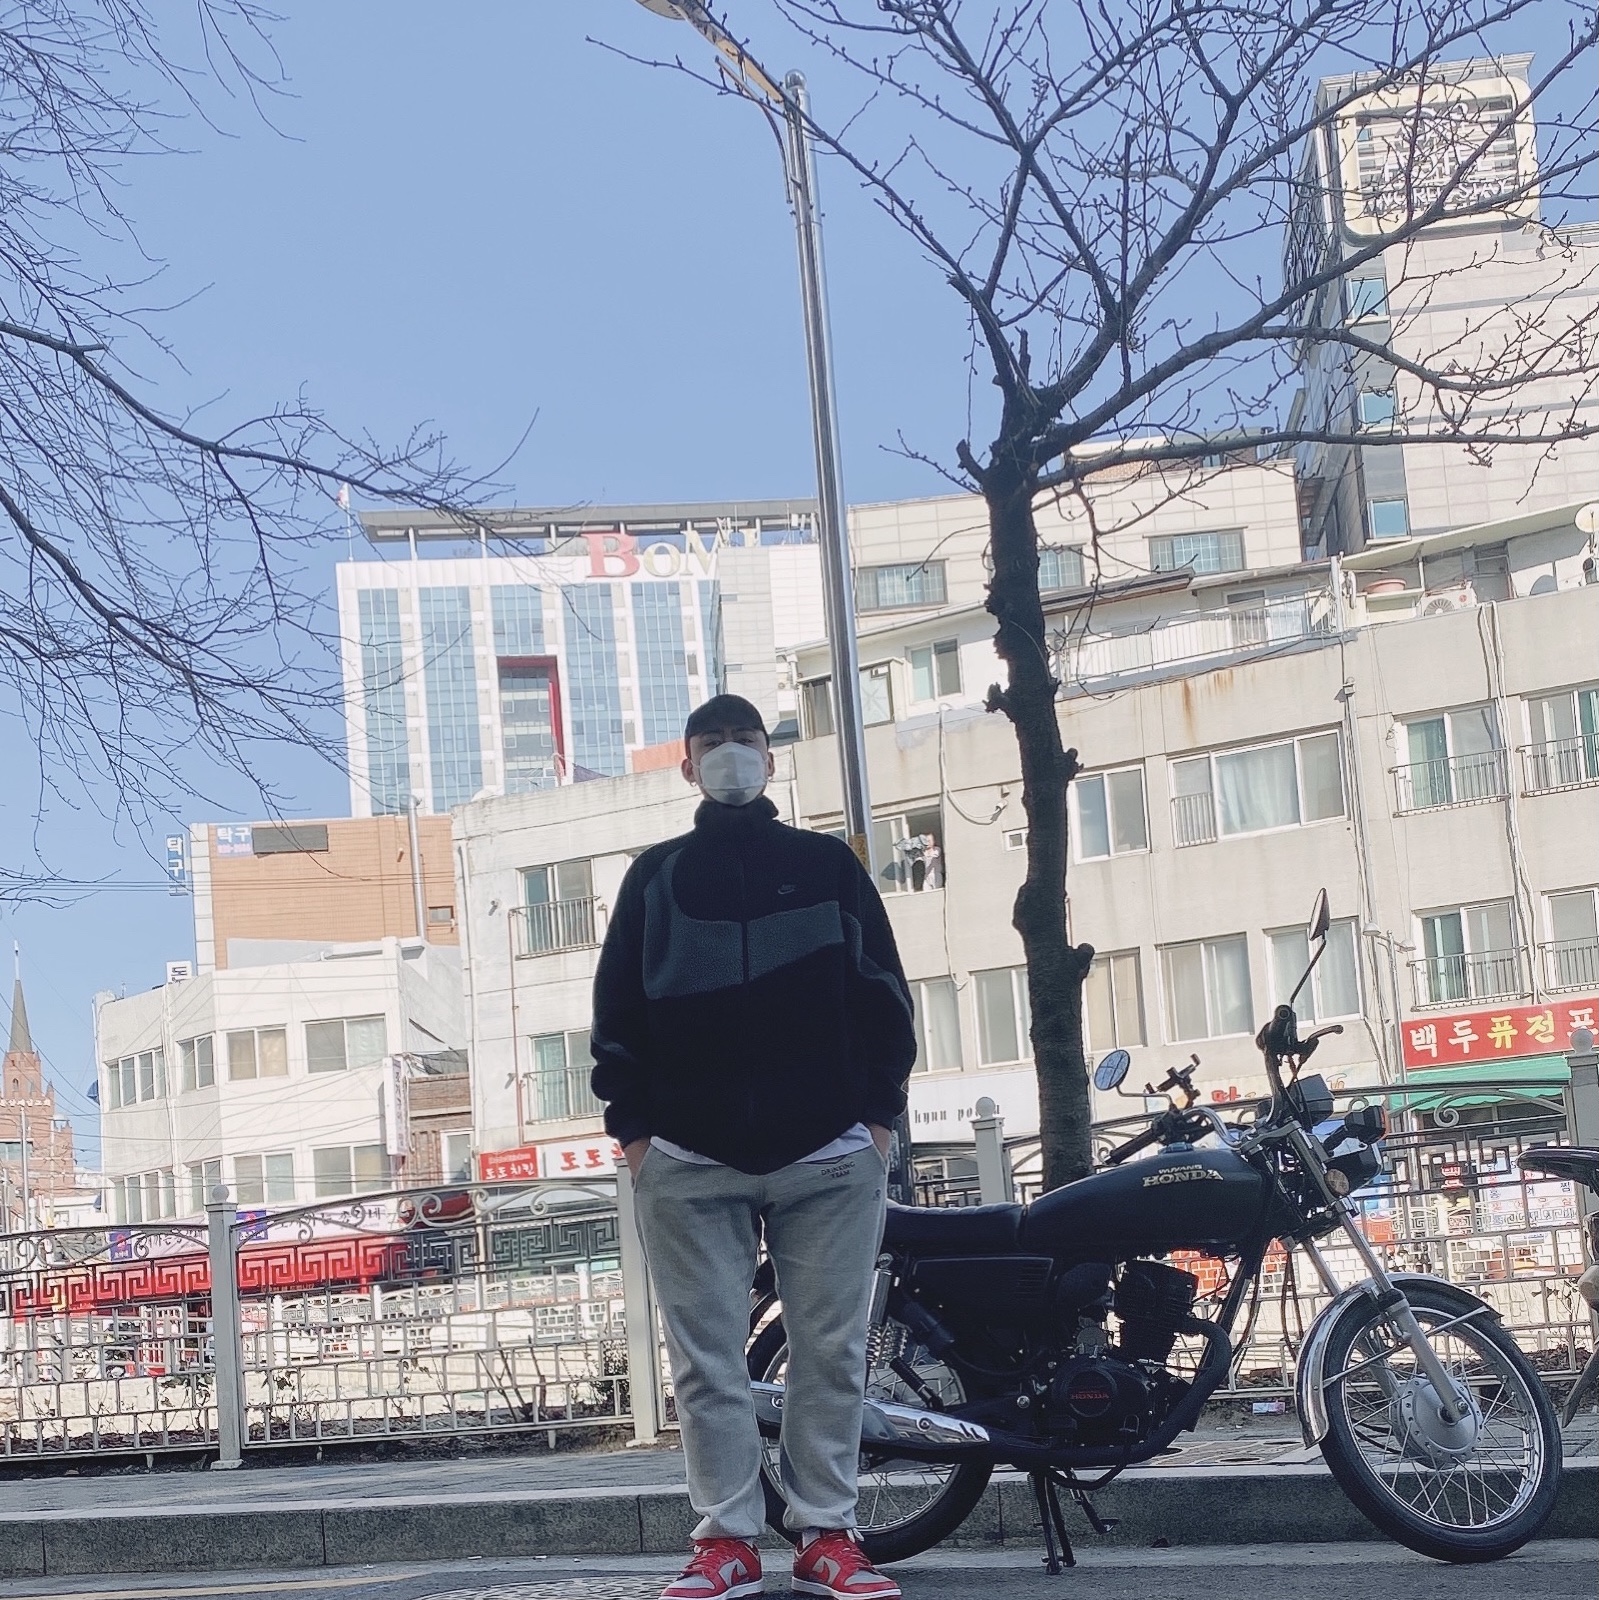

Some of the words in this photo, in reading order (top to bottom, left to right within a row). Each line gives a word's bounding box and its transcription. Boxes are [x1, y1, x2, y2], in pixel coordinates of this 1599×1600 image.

[217, 826, 251, 843] 탁구
[167, 837, 184, 878] 탁구
[821, 1161, 856, 1175] DRINKING
[832, 1169, 851, 1178] TEAM
[1142, 1169, 1224, 1187] HONDA
[1071, 1392, 1110, 1400] HONDA
